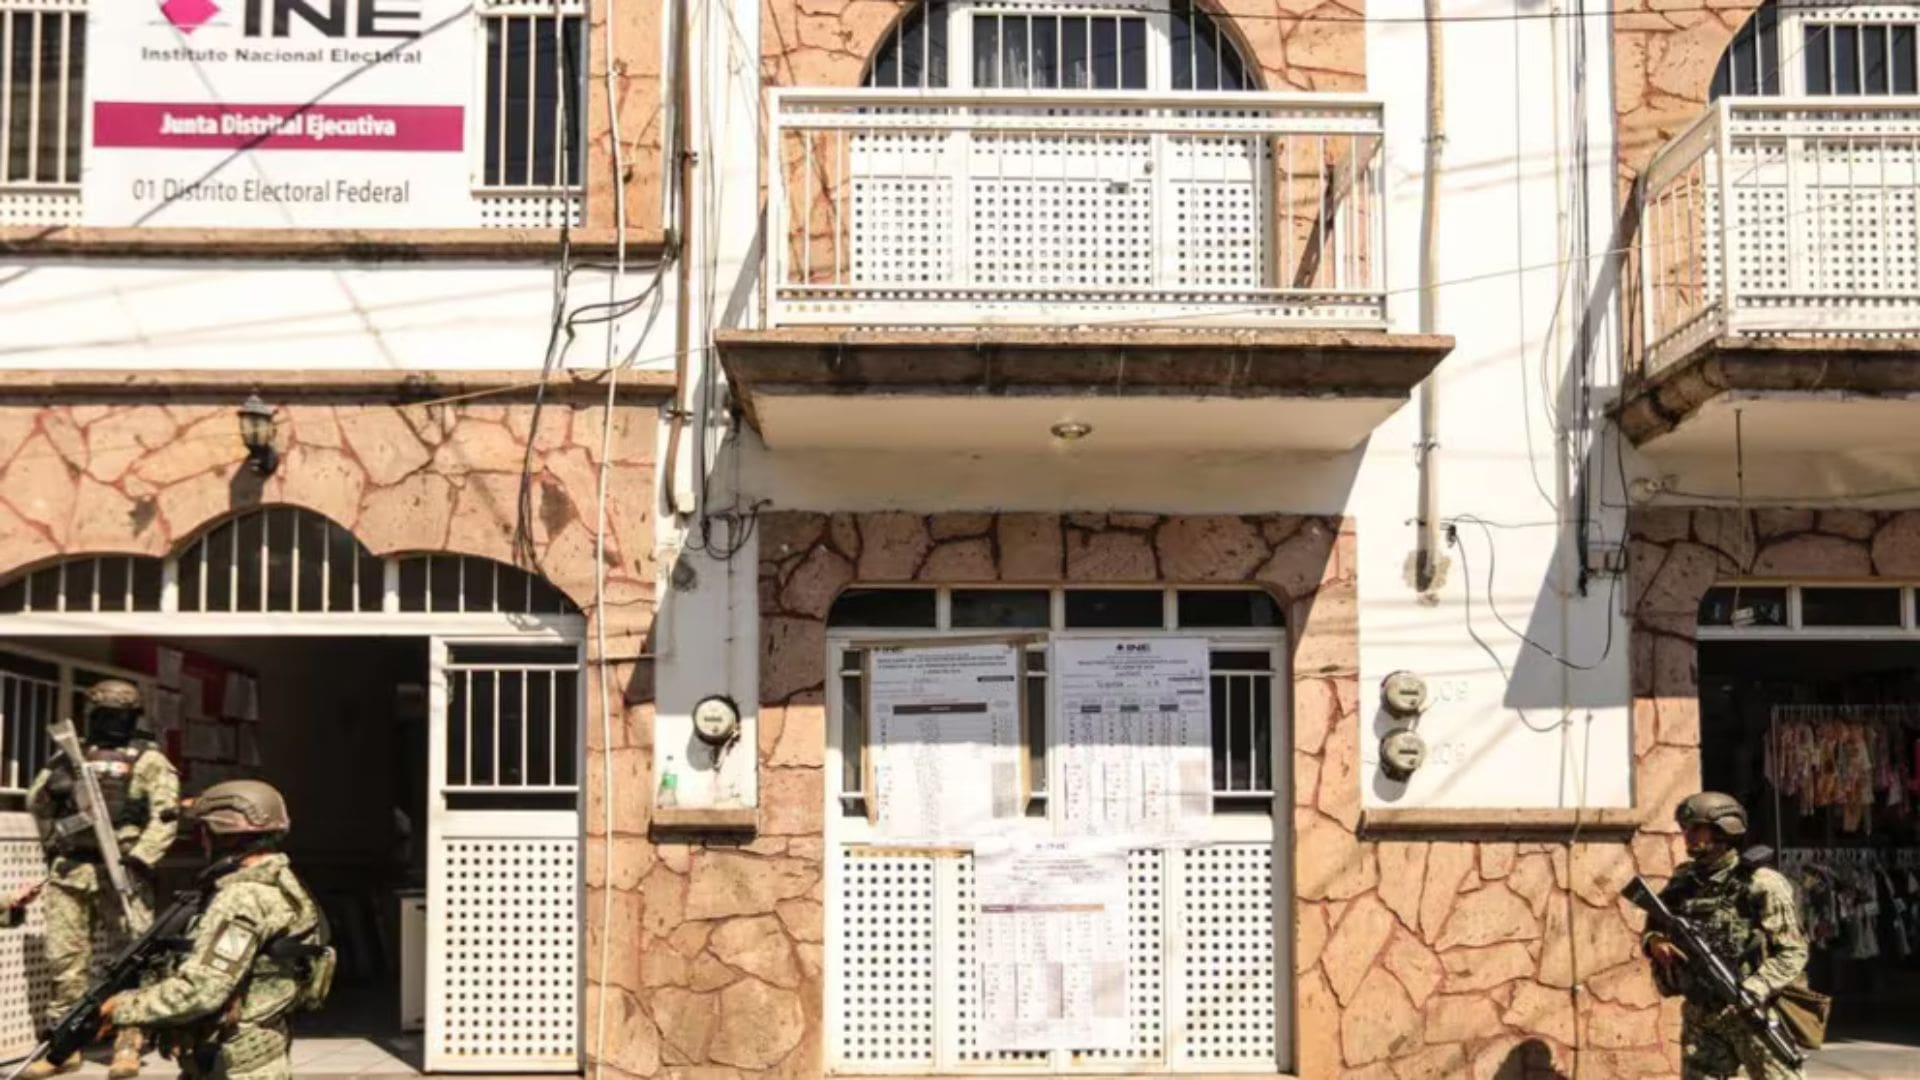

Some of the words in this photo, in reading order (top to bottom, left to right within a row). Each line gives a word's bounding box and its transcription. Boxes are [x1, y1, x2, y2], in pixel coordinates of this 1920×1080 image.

[244, 0, 421, 38] INE
[142, 47, 228, 62] Instituto
[235, 48, 323, 63] Nacional
[331, 48, 421, 63] Electoral
[160, 114, 218, 135] Junta
[221, 114, 302, 136] Distrital
[306, 114, 396, 140] Ejecutiva
[132, 179, 156, 200] 01
[163, 179, 238, 201] Distrito
[244, 179, 330, 202] Electoral
[336, 180, 410, 203] Federal
